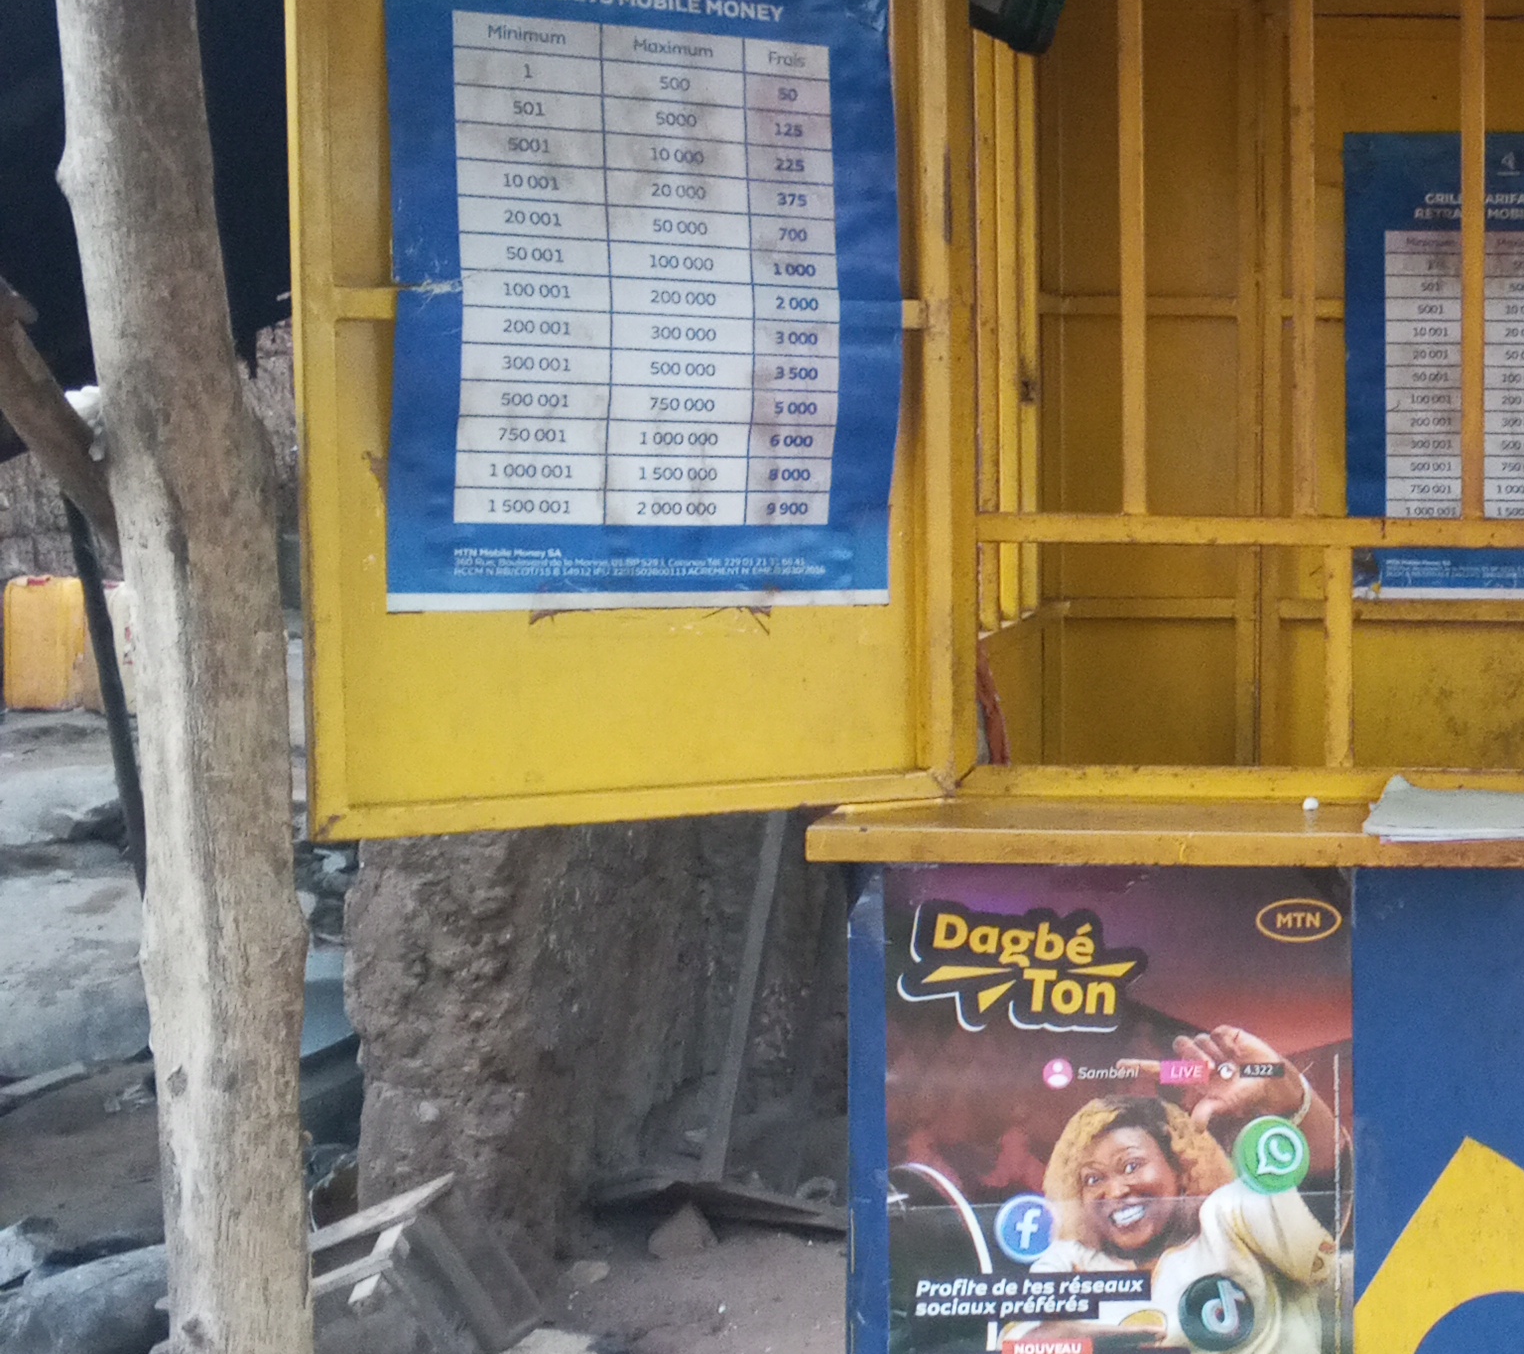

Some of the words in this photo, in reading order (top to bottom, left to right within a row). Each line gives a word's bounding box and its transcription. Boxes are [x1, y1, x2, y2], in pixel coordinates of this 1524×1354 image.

[488, 25, 566, 46] Minimum
[633, 36, 713, 58] Maximum
[768, 51, 805, 68] Frais
[660, 76, 691, 92] 500
[778, 87, 798, 102] 50
[513, 100, 545, 117] 501
[656, 111, 697, 128] 5000
[775, 122, 803, 138] 125
[508, 137, 550, 154] 5001
[651, 147, 670, 161] 10
[673, 149, 705, 165] 000
[775, 157, 805, 172] 225
[504, 173, 524, 188] 10
[527, 175, 559, 190] 001
[651, 183, 672, 197] 20
[675, 185, 707, 200] 000
[777, 192, 807, 207] 375
[505, 209, 526, 224] 20
[529, 211, 561, 227] 001
[653, 218, 673, 233] 50
[676, 220, 708, 235] 000
[779, 227, 807, 242] 700
[506, 246, 528, 261] 50
[531, 248, 564, 263] 001
[650, 254, 679, 269] 100
[683, 256, 714, 271] 000
[785, 263, 816, 277] 000
[504, 282, 535, 297] 100
[539, 284, 570, 299] 001
[651, 290, 681, 304] 200
[685, 291, 716, 306] 000
[789, 297, 819, 311] 000
[503, 319, 535, 334] 200
[539, 321, 570, 335] 001
[652, 326, 682, 340] 300
[685, 327, 717, 341] 000
[788, 331, 818, 346] 000
[503, 355, 535, 370] 300
[538, 357, 571, 372] 001
[650, 361, 681, 375] 500
[685, 363, 716, 377] 000
[789, 367, 818, 380] 500
[502, 393, 533, 407] 500
[537, 394, 568, 409] 001
[650, 397, 680, 412] 750
[684, 398, 715, 412] 000
[787, 402, 817, 415] 000
[499, 426, 530, 442] 750
[534, 428, 566, 443] 001
[653, 431, 684, 446] 000
[688, 432, 718, 446] 000
[783, 435, 814, 447] 000
[503, 463, 537, 478] 000
[541, 465, 572, 479] 001
[653, 467, 683, 481] 500
[687, 467, 718, 482] 000
[781, 468, 811, 481] 000
[503, 499, 535, 513] 500
[538, 500, 570, 514] 001
[651, 502, 682, 516] 000
[686, 501, 717, 516] 000
[780, 502, 808, 515] 900
[1276, 911, 1321, 929] MTN
[932, 913, 1096, 966] Dagbé
[1023, 968, 1117, 1015] Ton
[1170, 1066, 1203, 1079] LIVE
[916, 1279, 987, 1298] Profite
[992, 1279, 1015, 1295] de
[1024, 1279, 1053, 1295] tes
[1059, 1275, 1144, 1294] réseaux
[915, 1298, 996, 1316] sociaux
[1000, 1296, 1089, 1318] préférés
[1014, 1343, 1082, 1354] NOUVEAU
